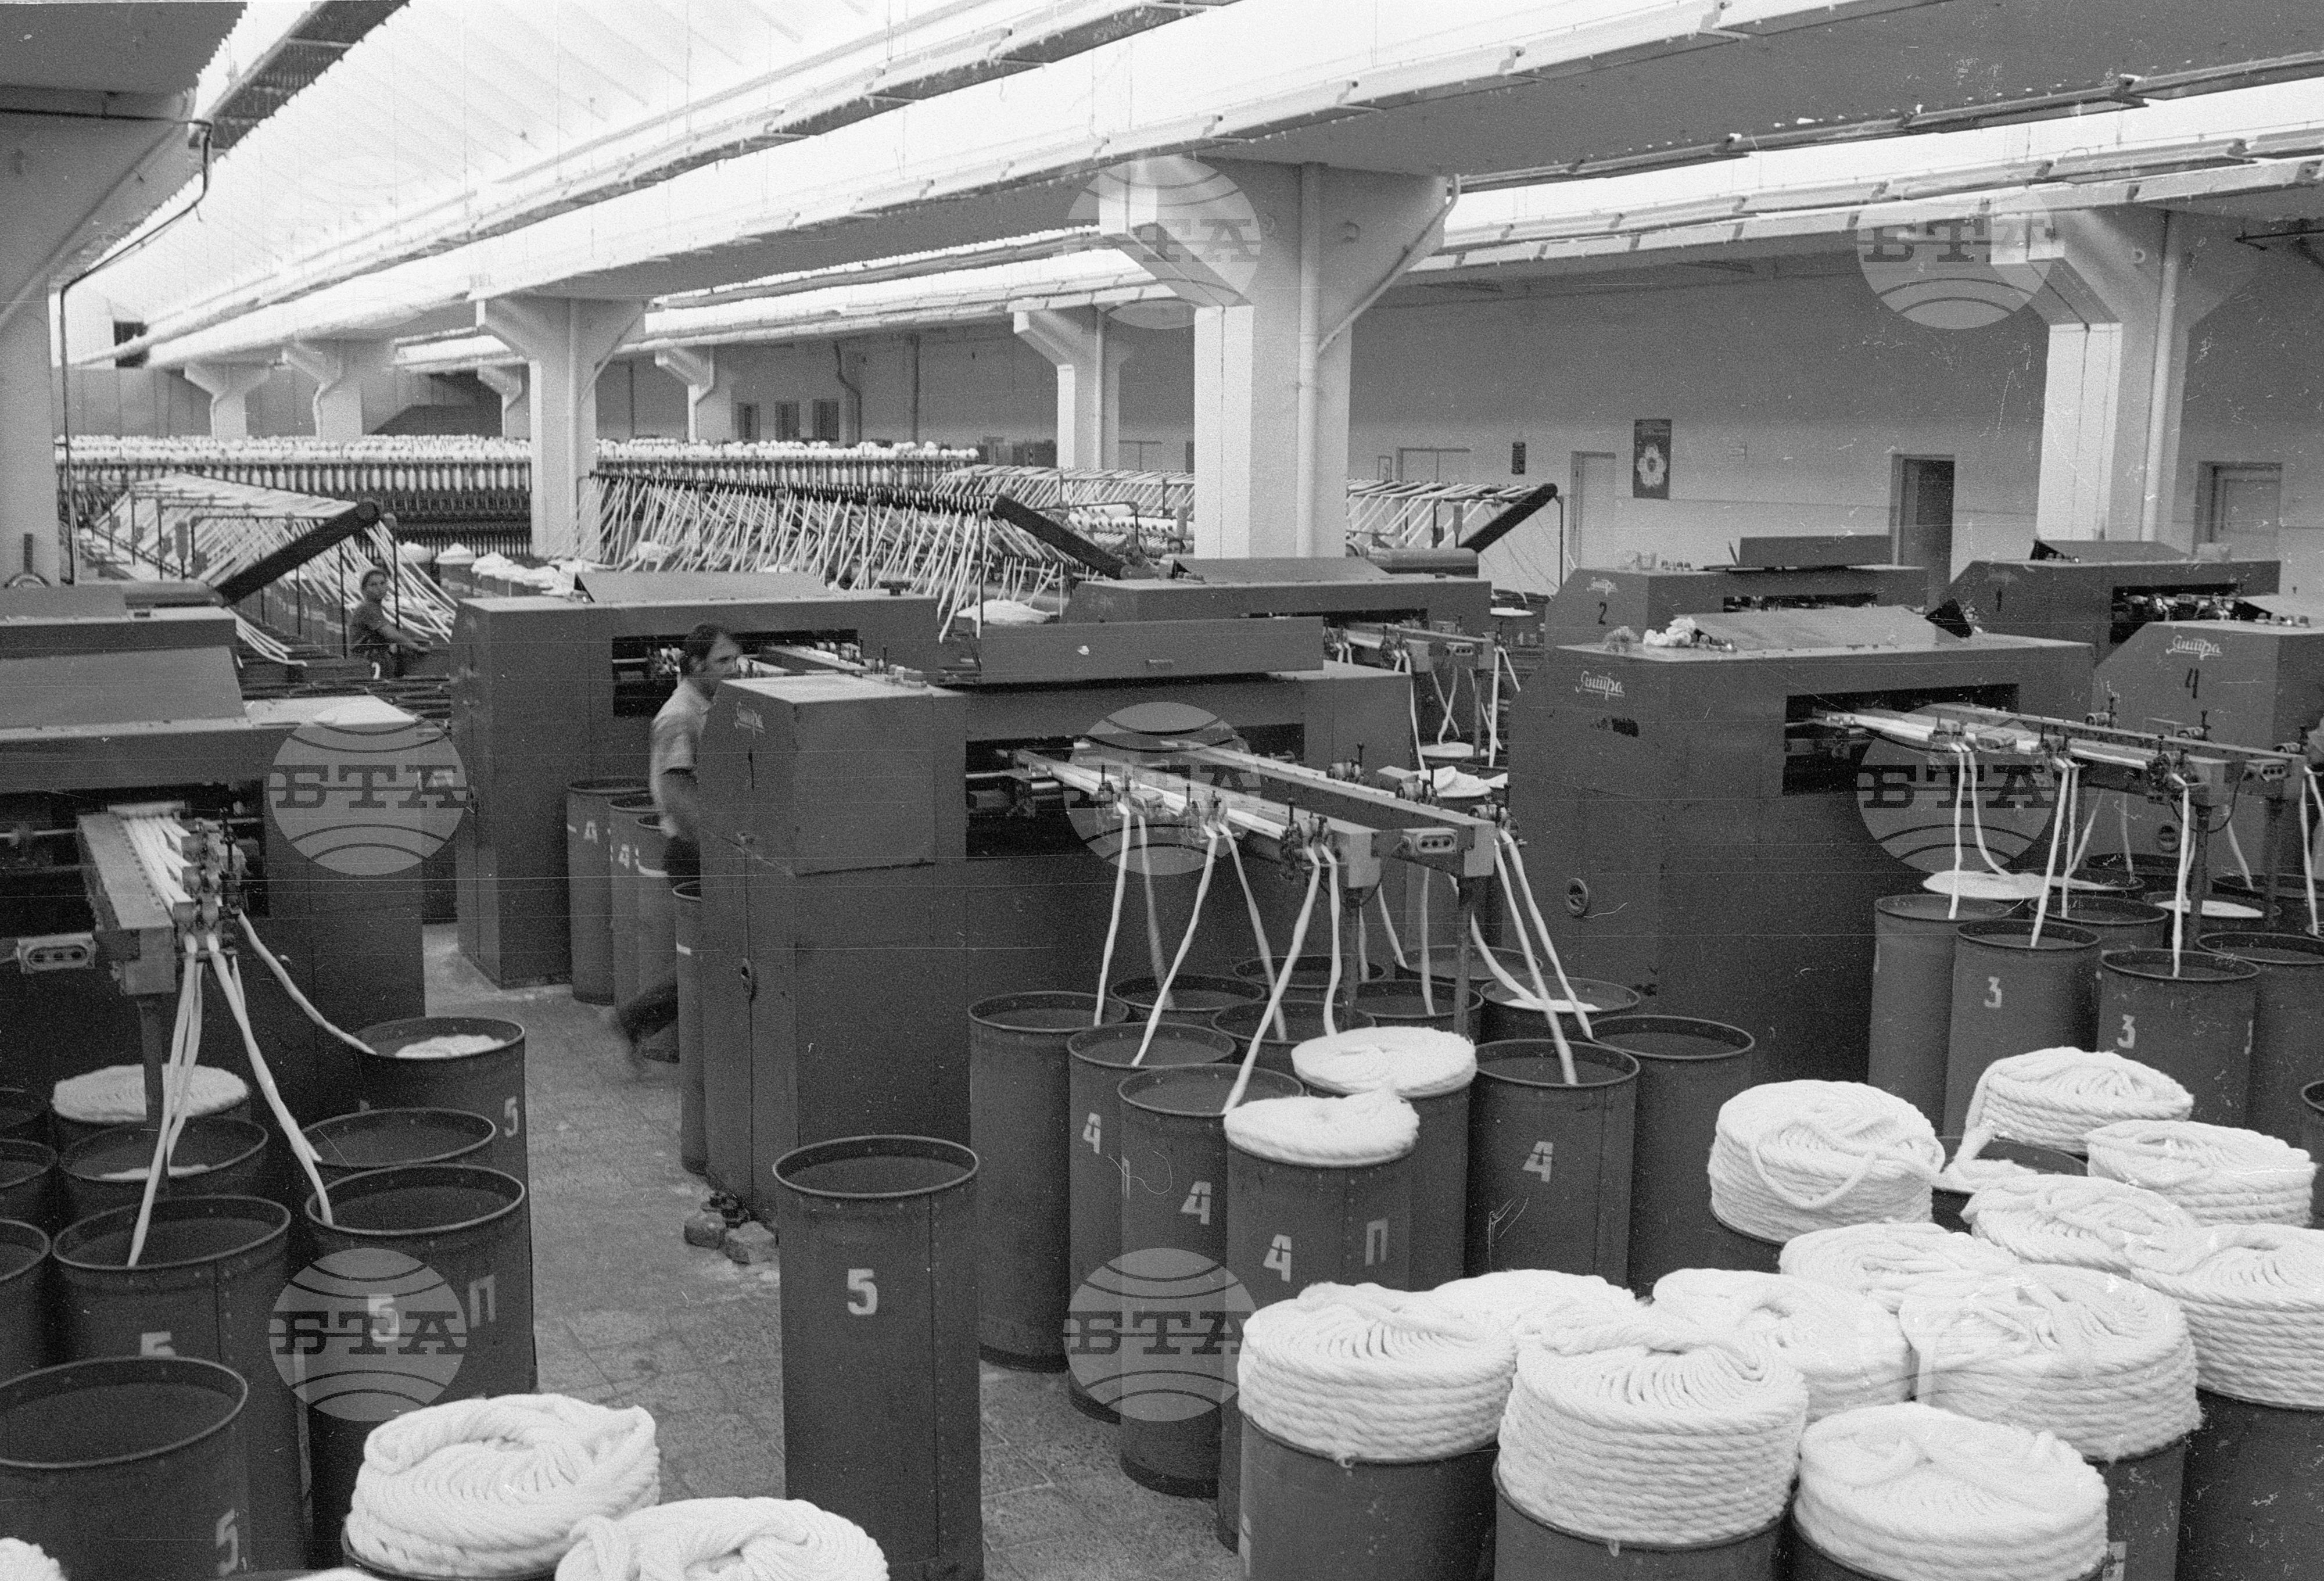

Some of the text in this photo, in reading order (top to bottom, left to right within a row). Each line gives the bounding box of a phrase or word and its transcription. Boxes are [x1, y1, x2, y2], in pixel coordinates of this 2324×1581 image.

[1598, 601, 1608, 626] 2
[2185, 668, 2200, 700] 4
[1984, 976, 2002, 1008] 3
[2117, 1014, 2136, 1048] 3
[504, 1096, 518, 1137] 5
[1082, 1113, 1101, 1154] 4
[1523, 1141, 1554, 1182] 4
[1181, 1181, 1211, 1225] 4
[1263, 1234, 1292, 1282] 4
[847, 1268, 878, 1315] 5
[367, 1293, 400, 1343] 5
[217, 1508, 239, 1576] 5
